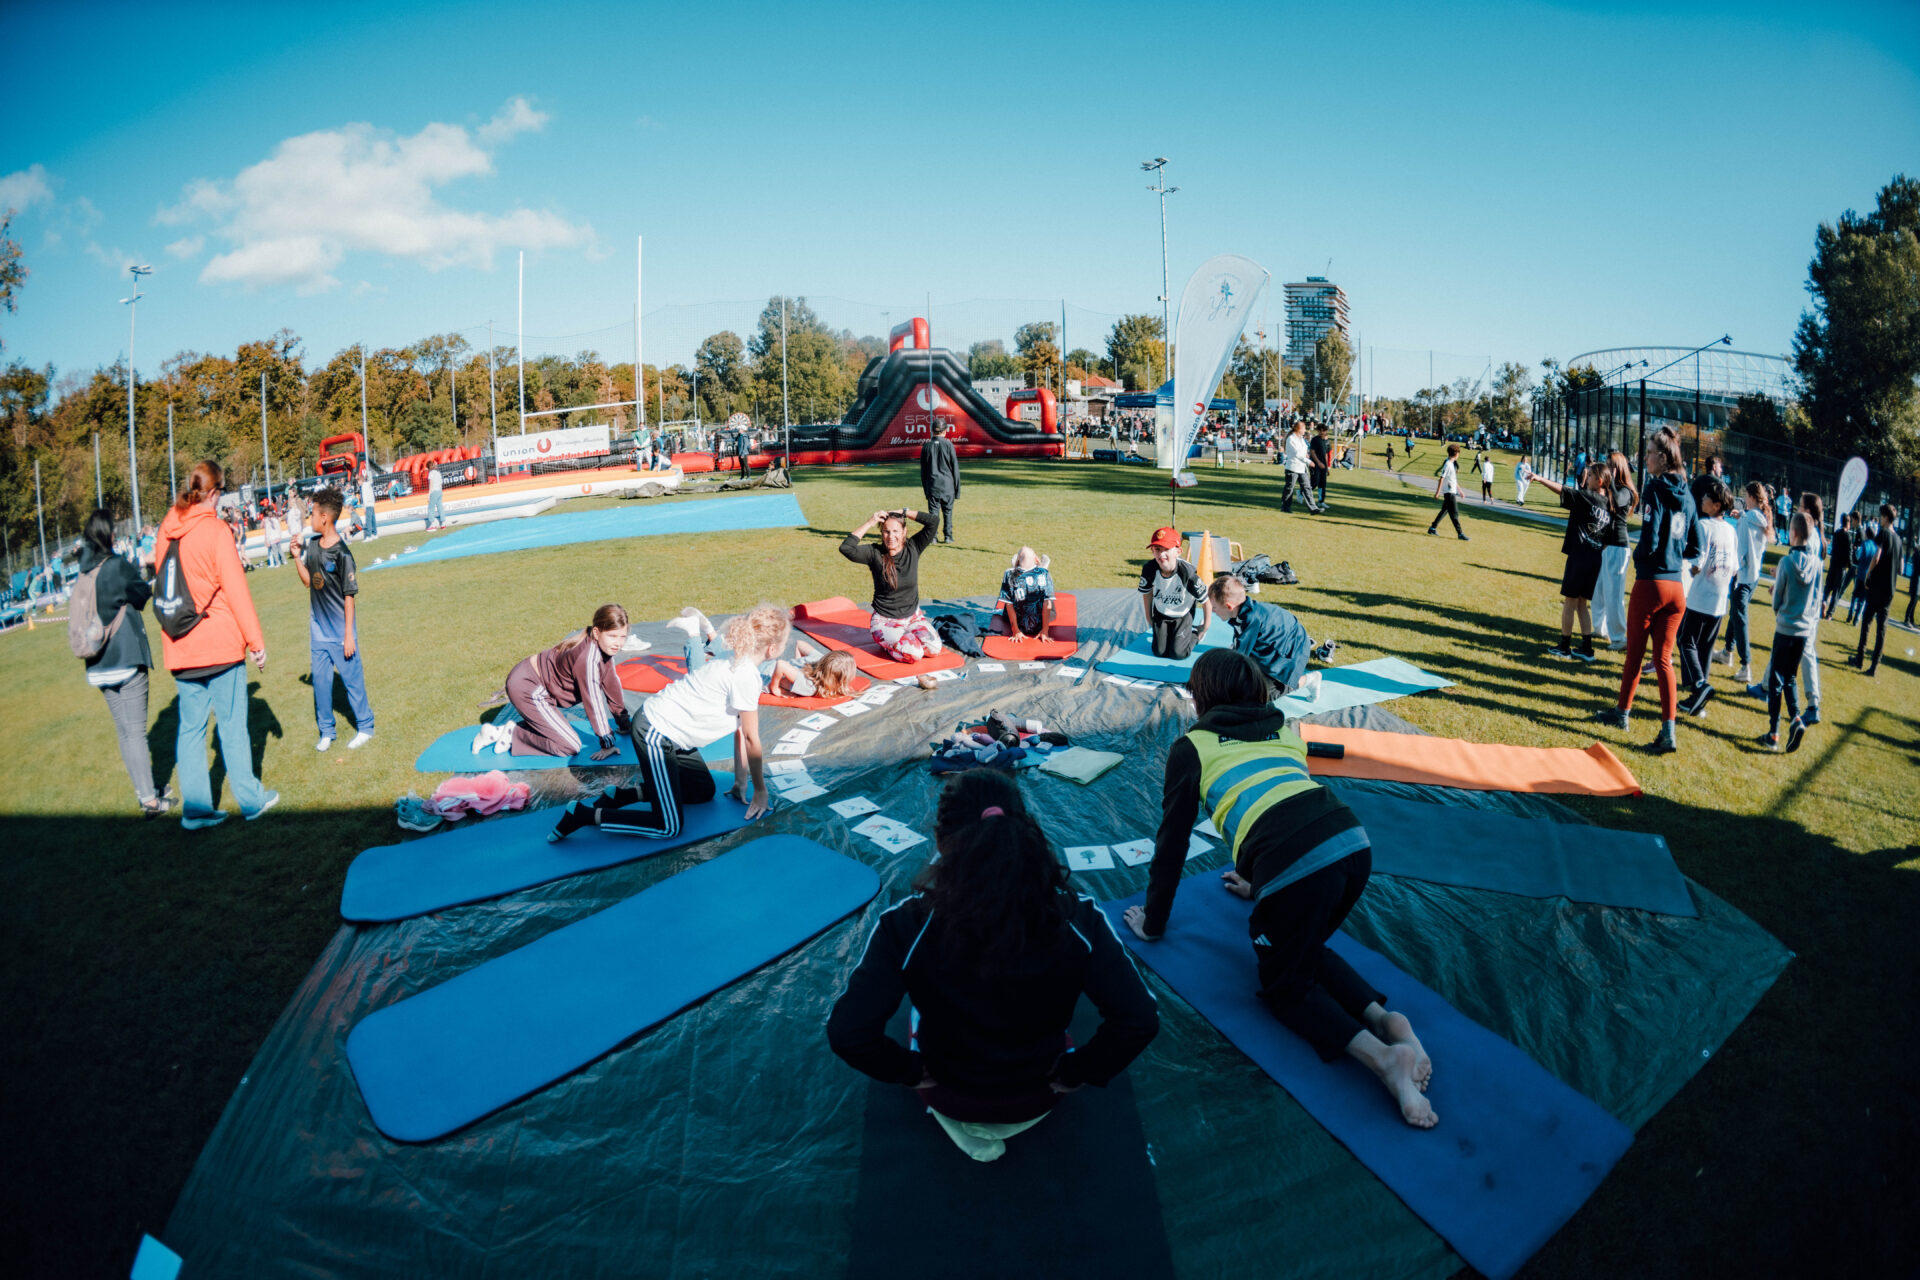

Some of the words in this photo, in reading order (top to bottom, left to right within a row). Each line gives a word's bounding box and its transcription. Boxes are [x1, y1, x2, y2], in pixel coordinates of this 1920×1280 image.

[905, 424, 956, 433] unn
[1186, 416, 1200, 444] union
[503, 447, 535, 457] union
[443, 474, 467, 484] nion
